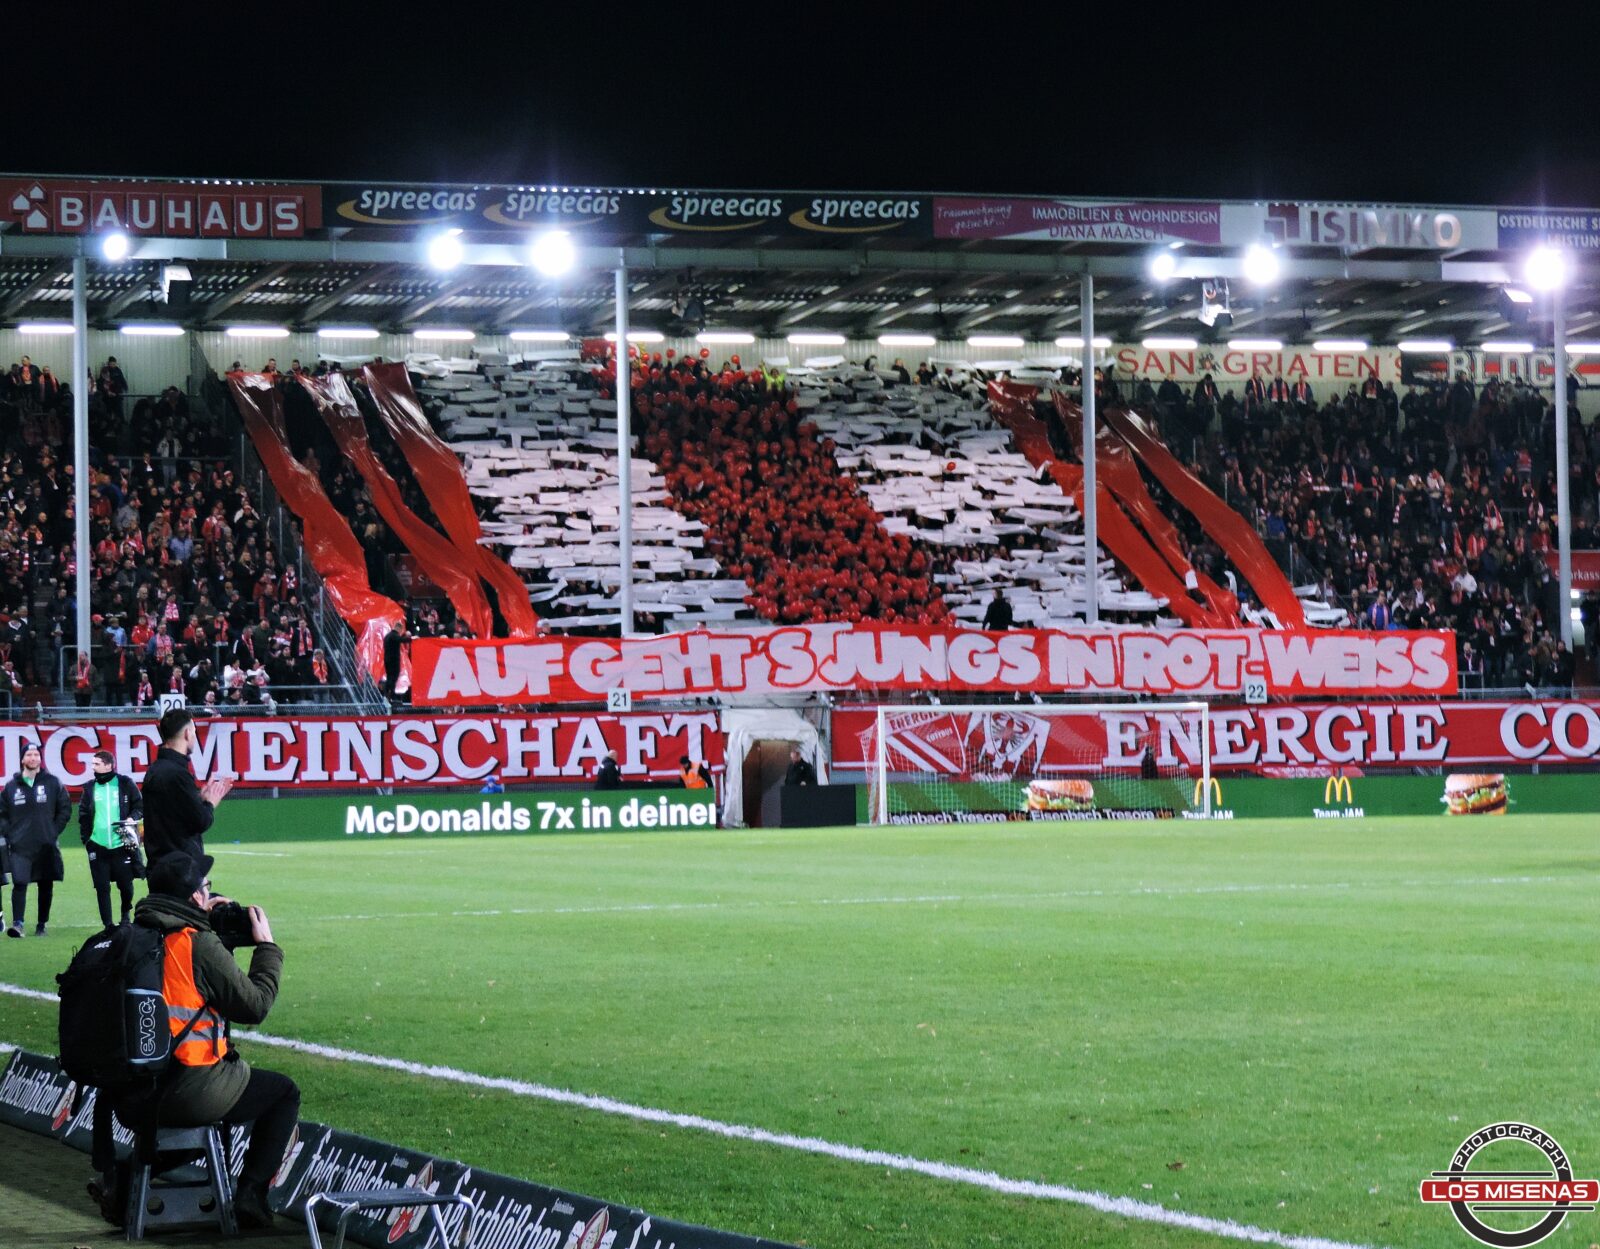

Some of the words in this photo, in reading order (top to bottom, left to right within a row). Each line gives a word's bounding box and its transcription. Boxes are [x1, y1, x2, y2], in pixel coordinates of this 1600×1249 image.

[60, 196, 302, 231] BAUHAUS
[1032, 206, 1110, 221] IMMOBILIEN
[1114, 208, 1124, 222] &
[1128, 208, 1218, 224] WOHNDESIGN
[1500, 214, 1587, 230] OSTDEUTSCHE
[1050, 225, 1097, 239] DIANA
[1101, 226, 1165, 241] MAASCH
[1310, 210, 1462, 248] ISIMKO
[1118, 349, 1195, 375] SAN
[1445, 350, 1587, 389] BLOCK
[427, 641, 565, 700] AUF
[568, 630, 818, 694] GEHT'S
[820, 630, 1042, 686] JUNGS
[1048, 634, 1116, 688] IN
[612, 691, 628, 706] 21
[1248, 684, 1265, 699] 22
[1102, 704, 1449, 768] ENERGIE
[345, 801, 531, 834] McDonalds
[537, 801, 575, 829] 7x
[581, 797, 612, 828] in
